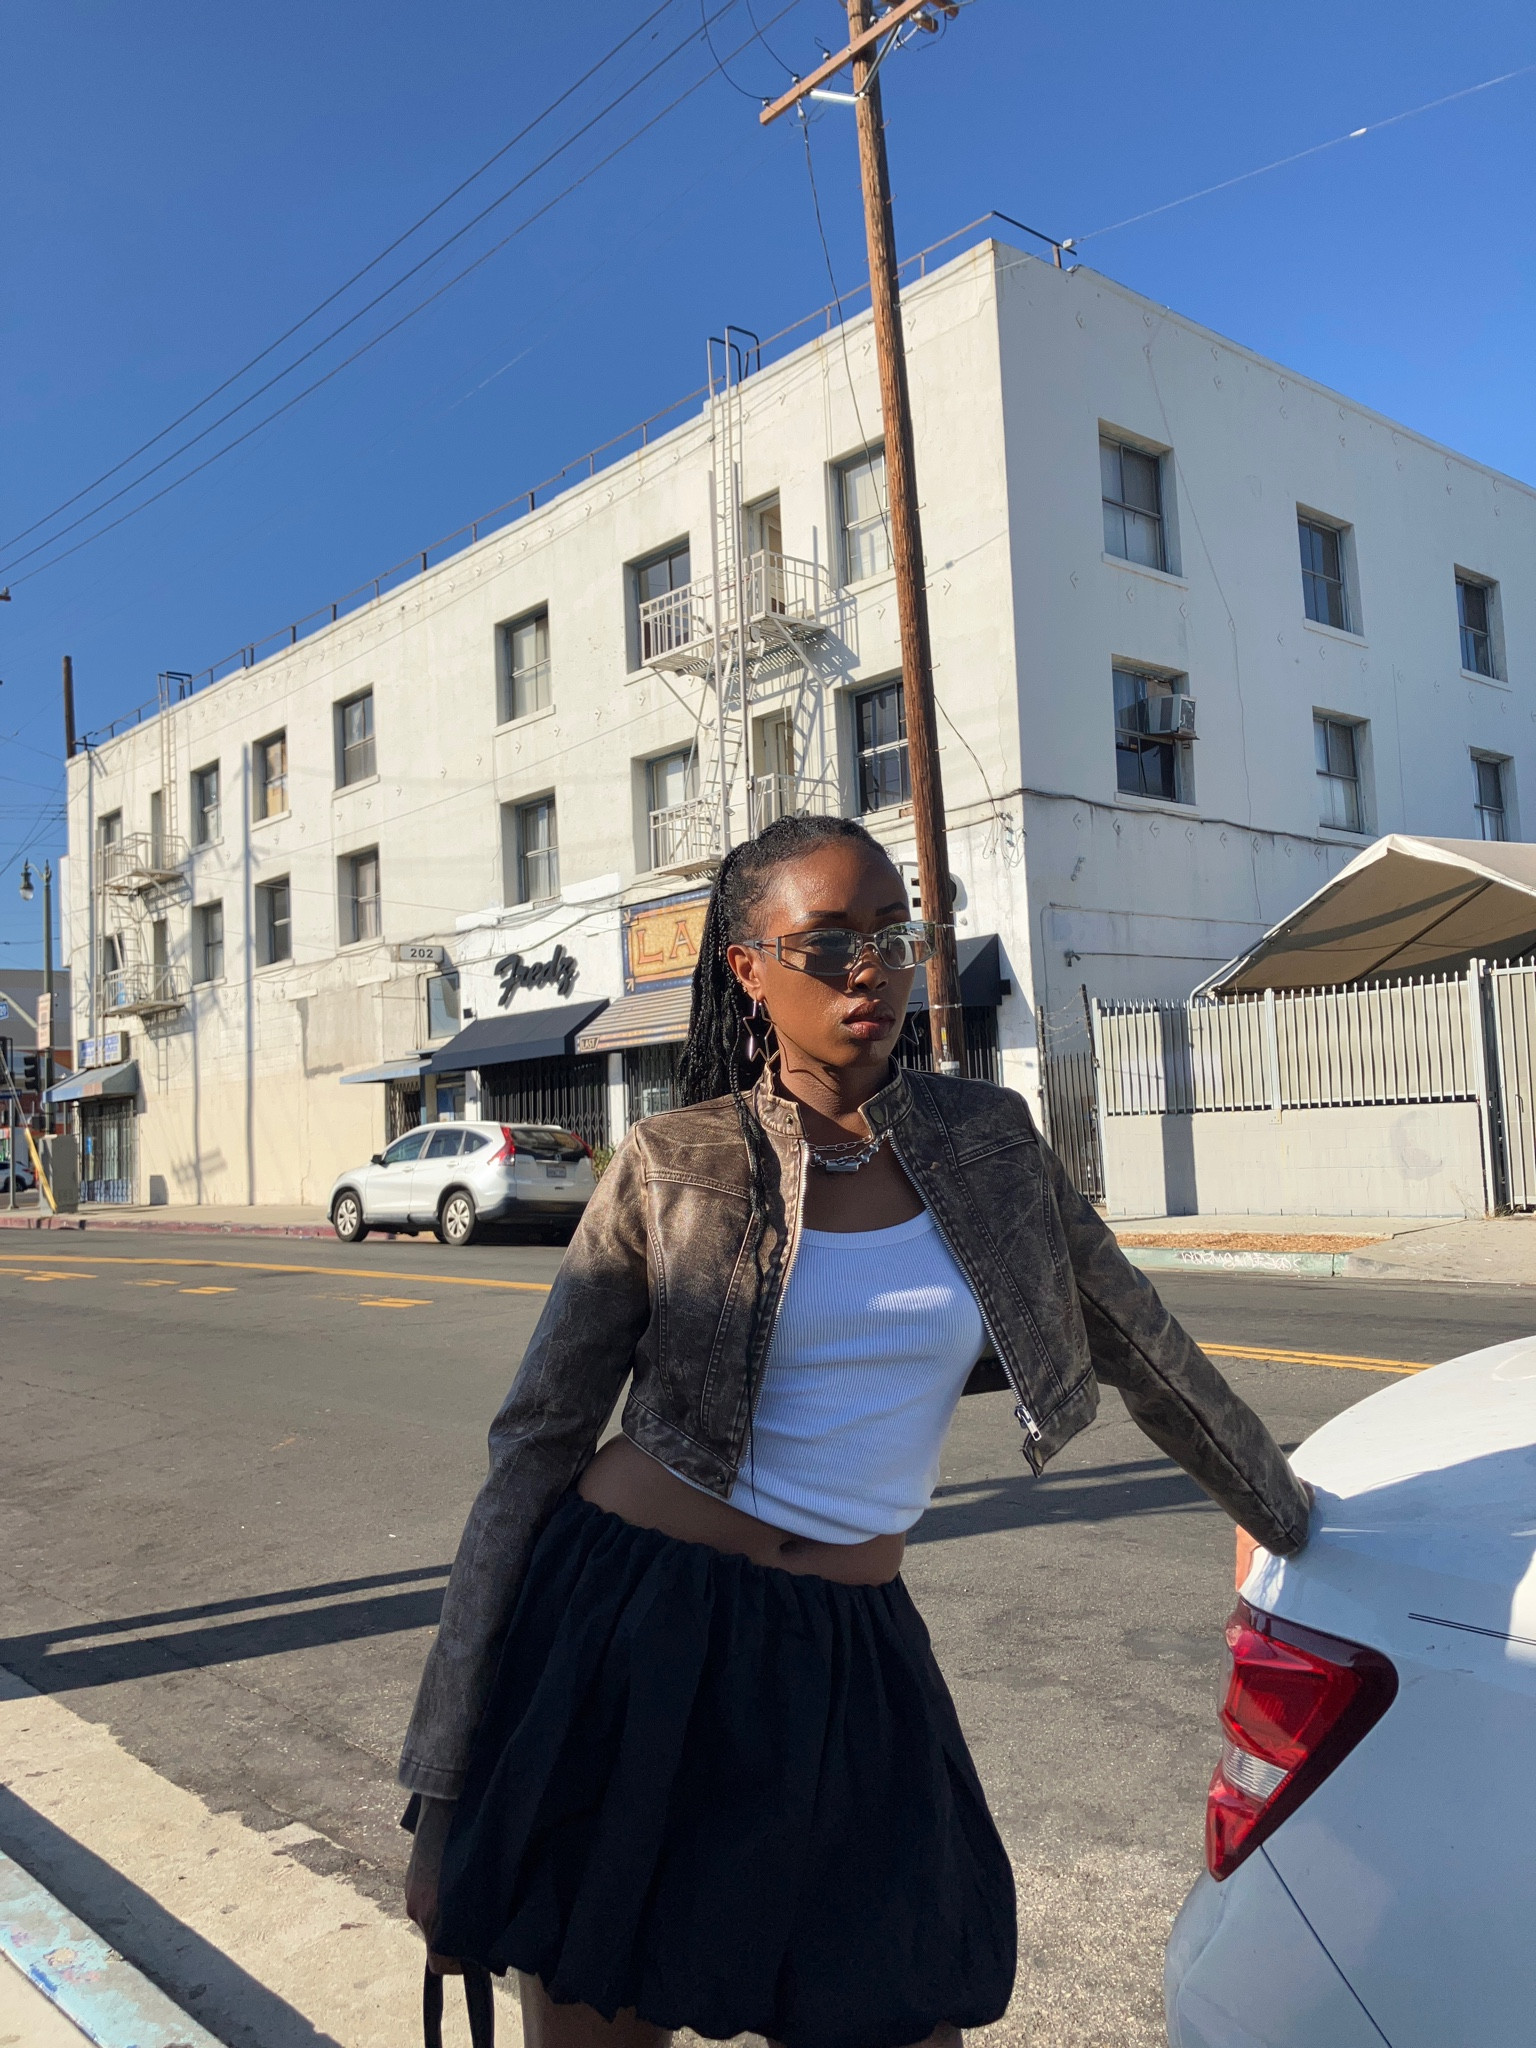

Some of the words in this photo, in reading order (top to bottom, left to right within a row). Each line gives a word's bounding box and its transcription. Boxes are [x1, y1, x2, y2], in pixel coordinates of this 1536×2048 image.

[410, 948, 433, 958] 202
[636, 920, 698, 965] LA
[494, 944, 577, 1007] Fredz
[580, 1038, 597, 1050] LAST
